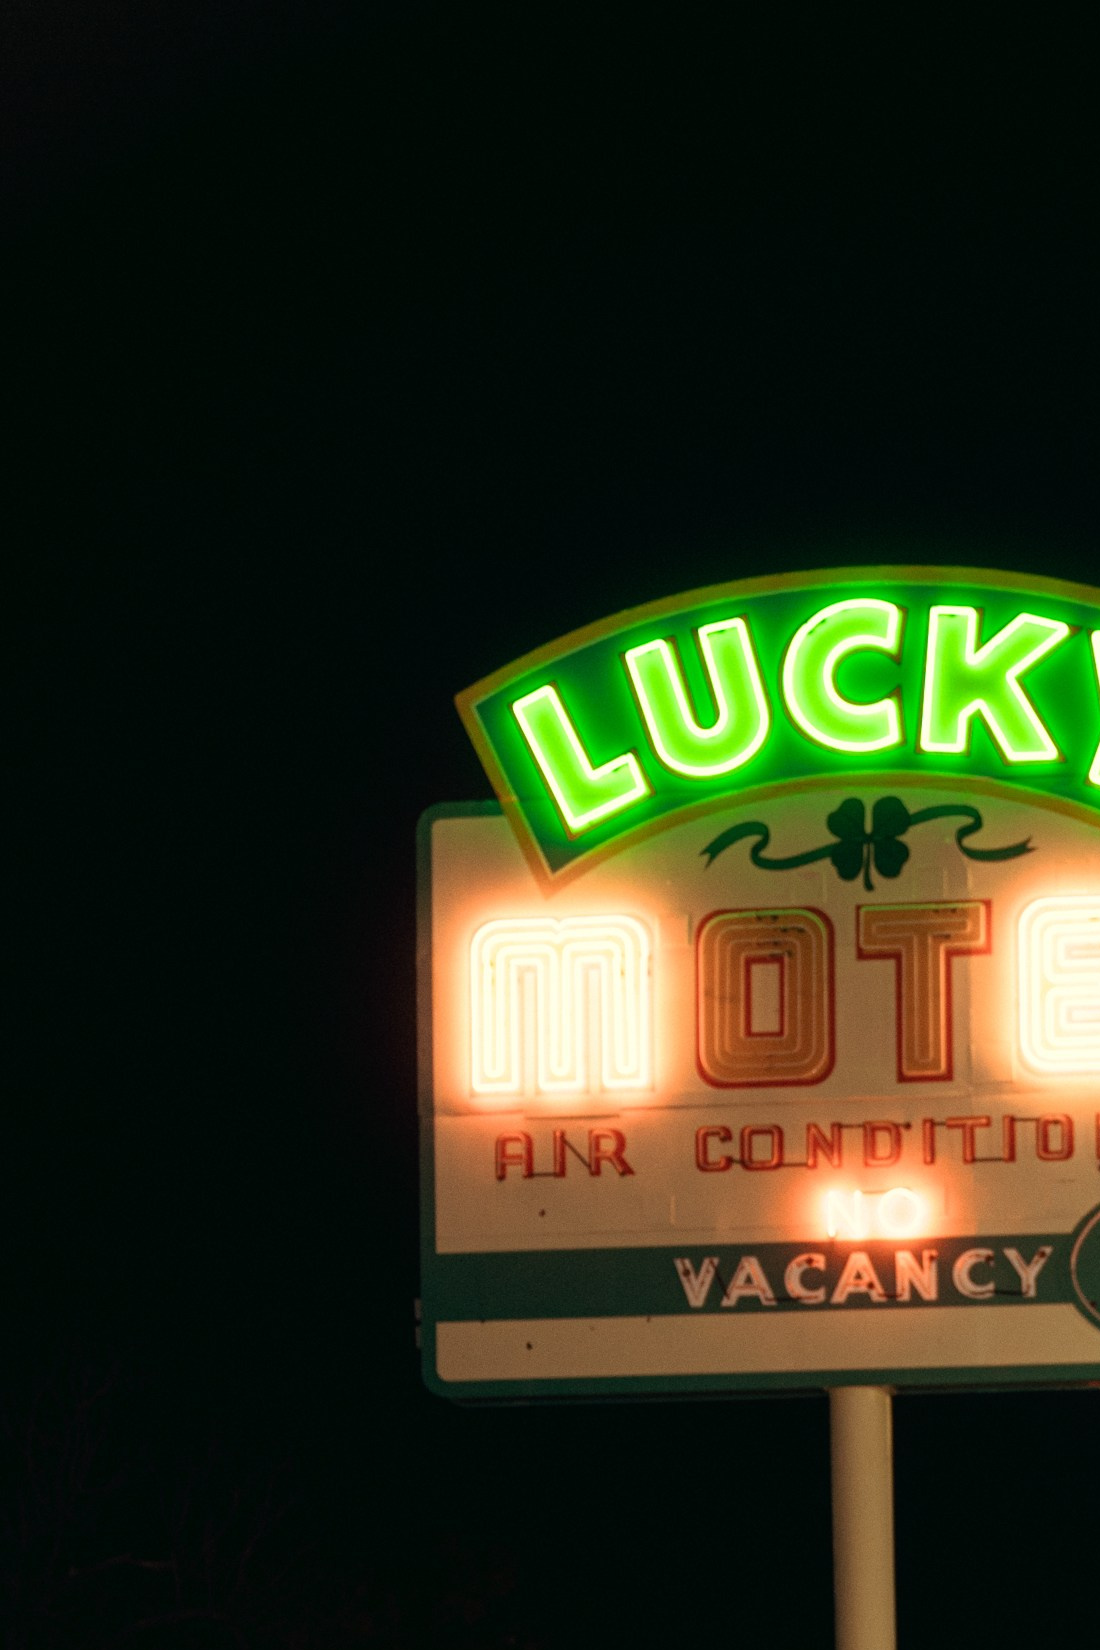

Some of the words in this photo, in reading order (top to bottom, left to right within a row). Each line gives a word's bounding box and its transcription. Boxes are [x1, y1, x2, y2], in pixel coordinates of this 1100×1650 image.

[494, 1127, 634, 1179] AIR
[826, 1186, 926, 1238] NO
[673, 1245, 1053, 1308] VACANCY
